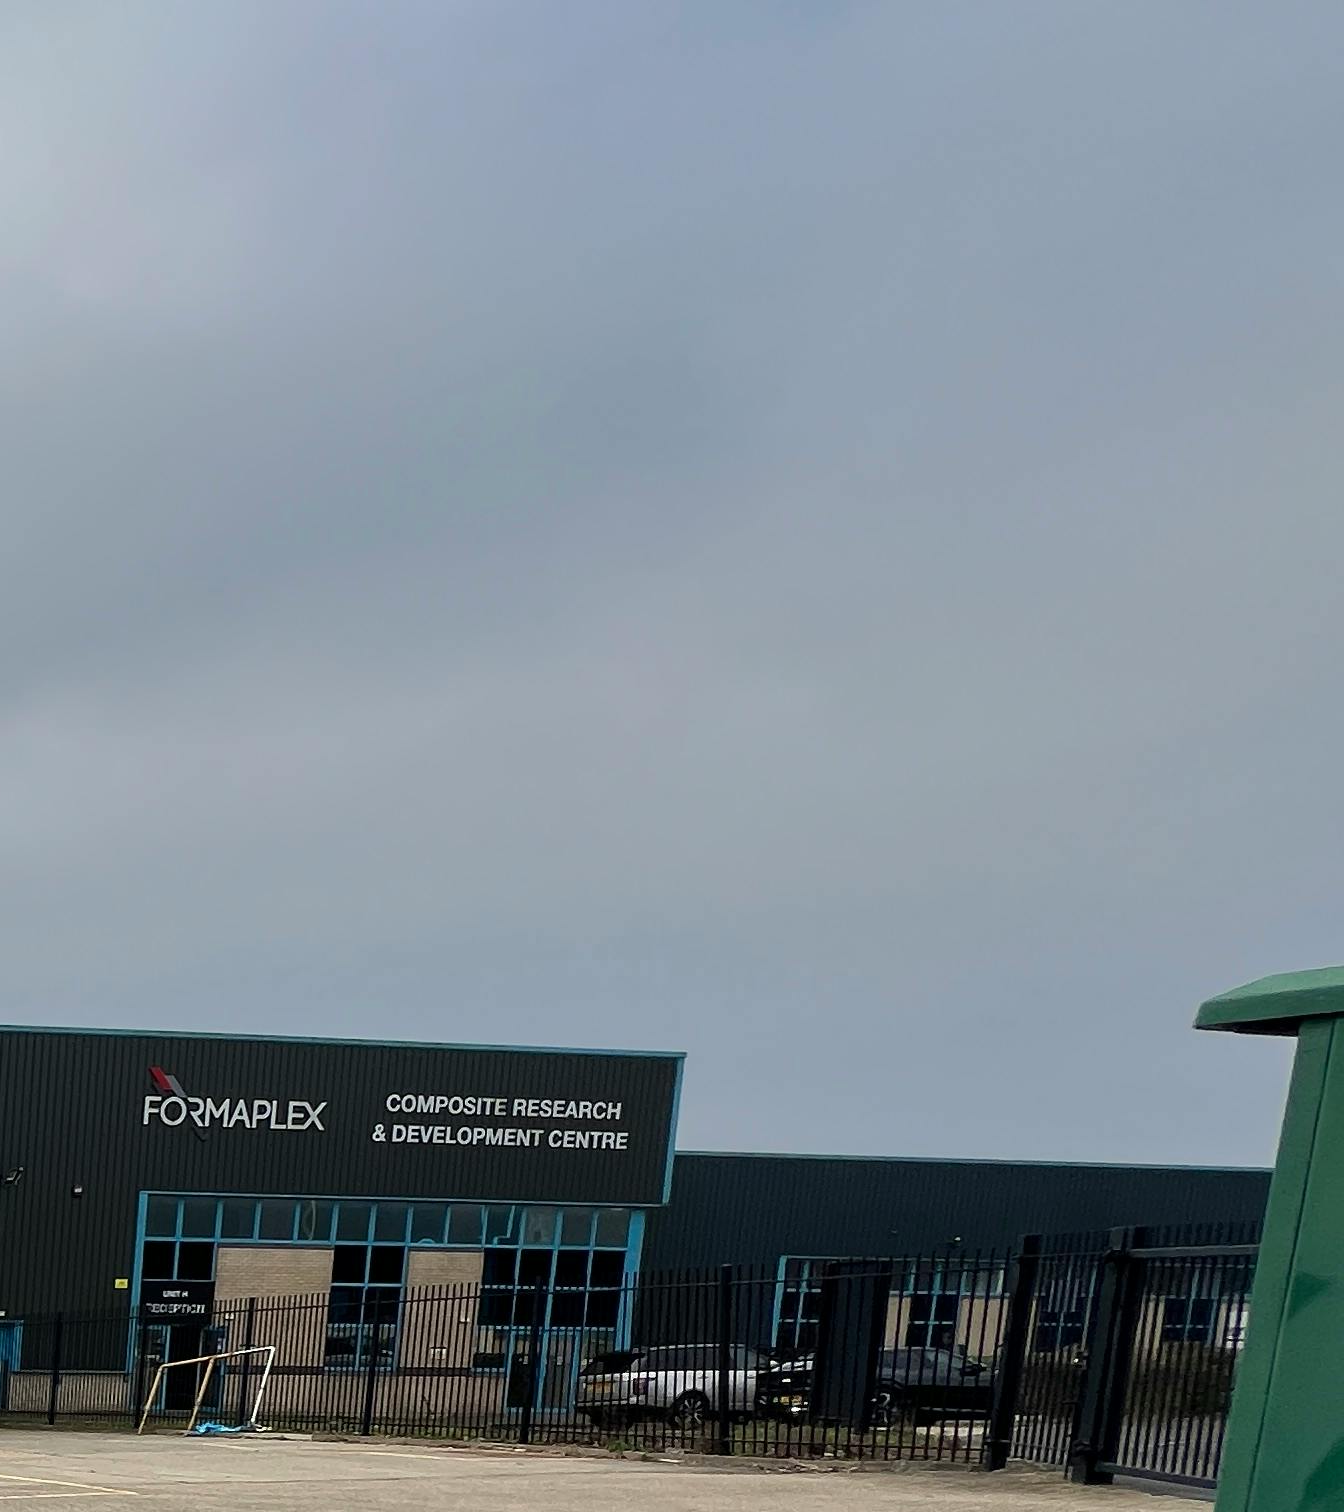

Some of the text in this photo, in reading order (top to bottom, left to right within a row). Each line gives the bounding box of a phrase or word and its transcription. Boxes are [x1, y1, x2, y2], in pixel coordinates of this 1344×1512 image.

[143, 1095, 328, 1131] FORMAPLEX
[386, 1094, 622, 1120] COMPOSITE RESEARCH
[372, 1123, 629, 1150] & DEVELOPMENT CENTRE
